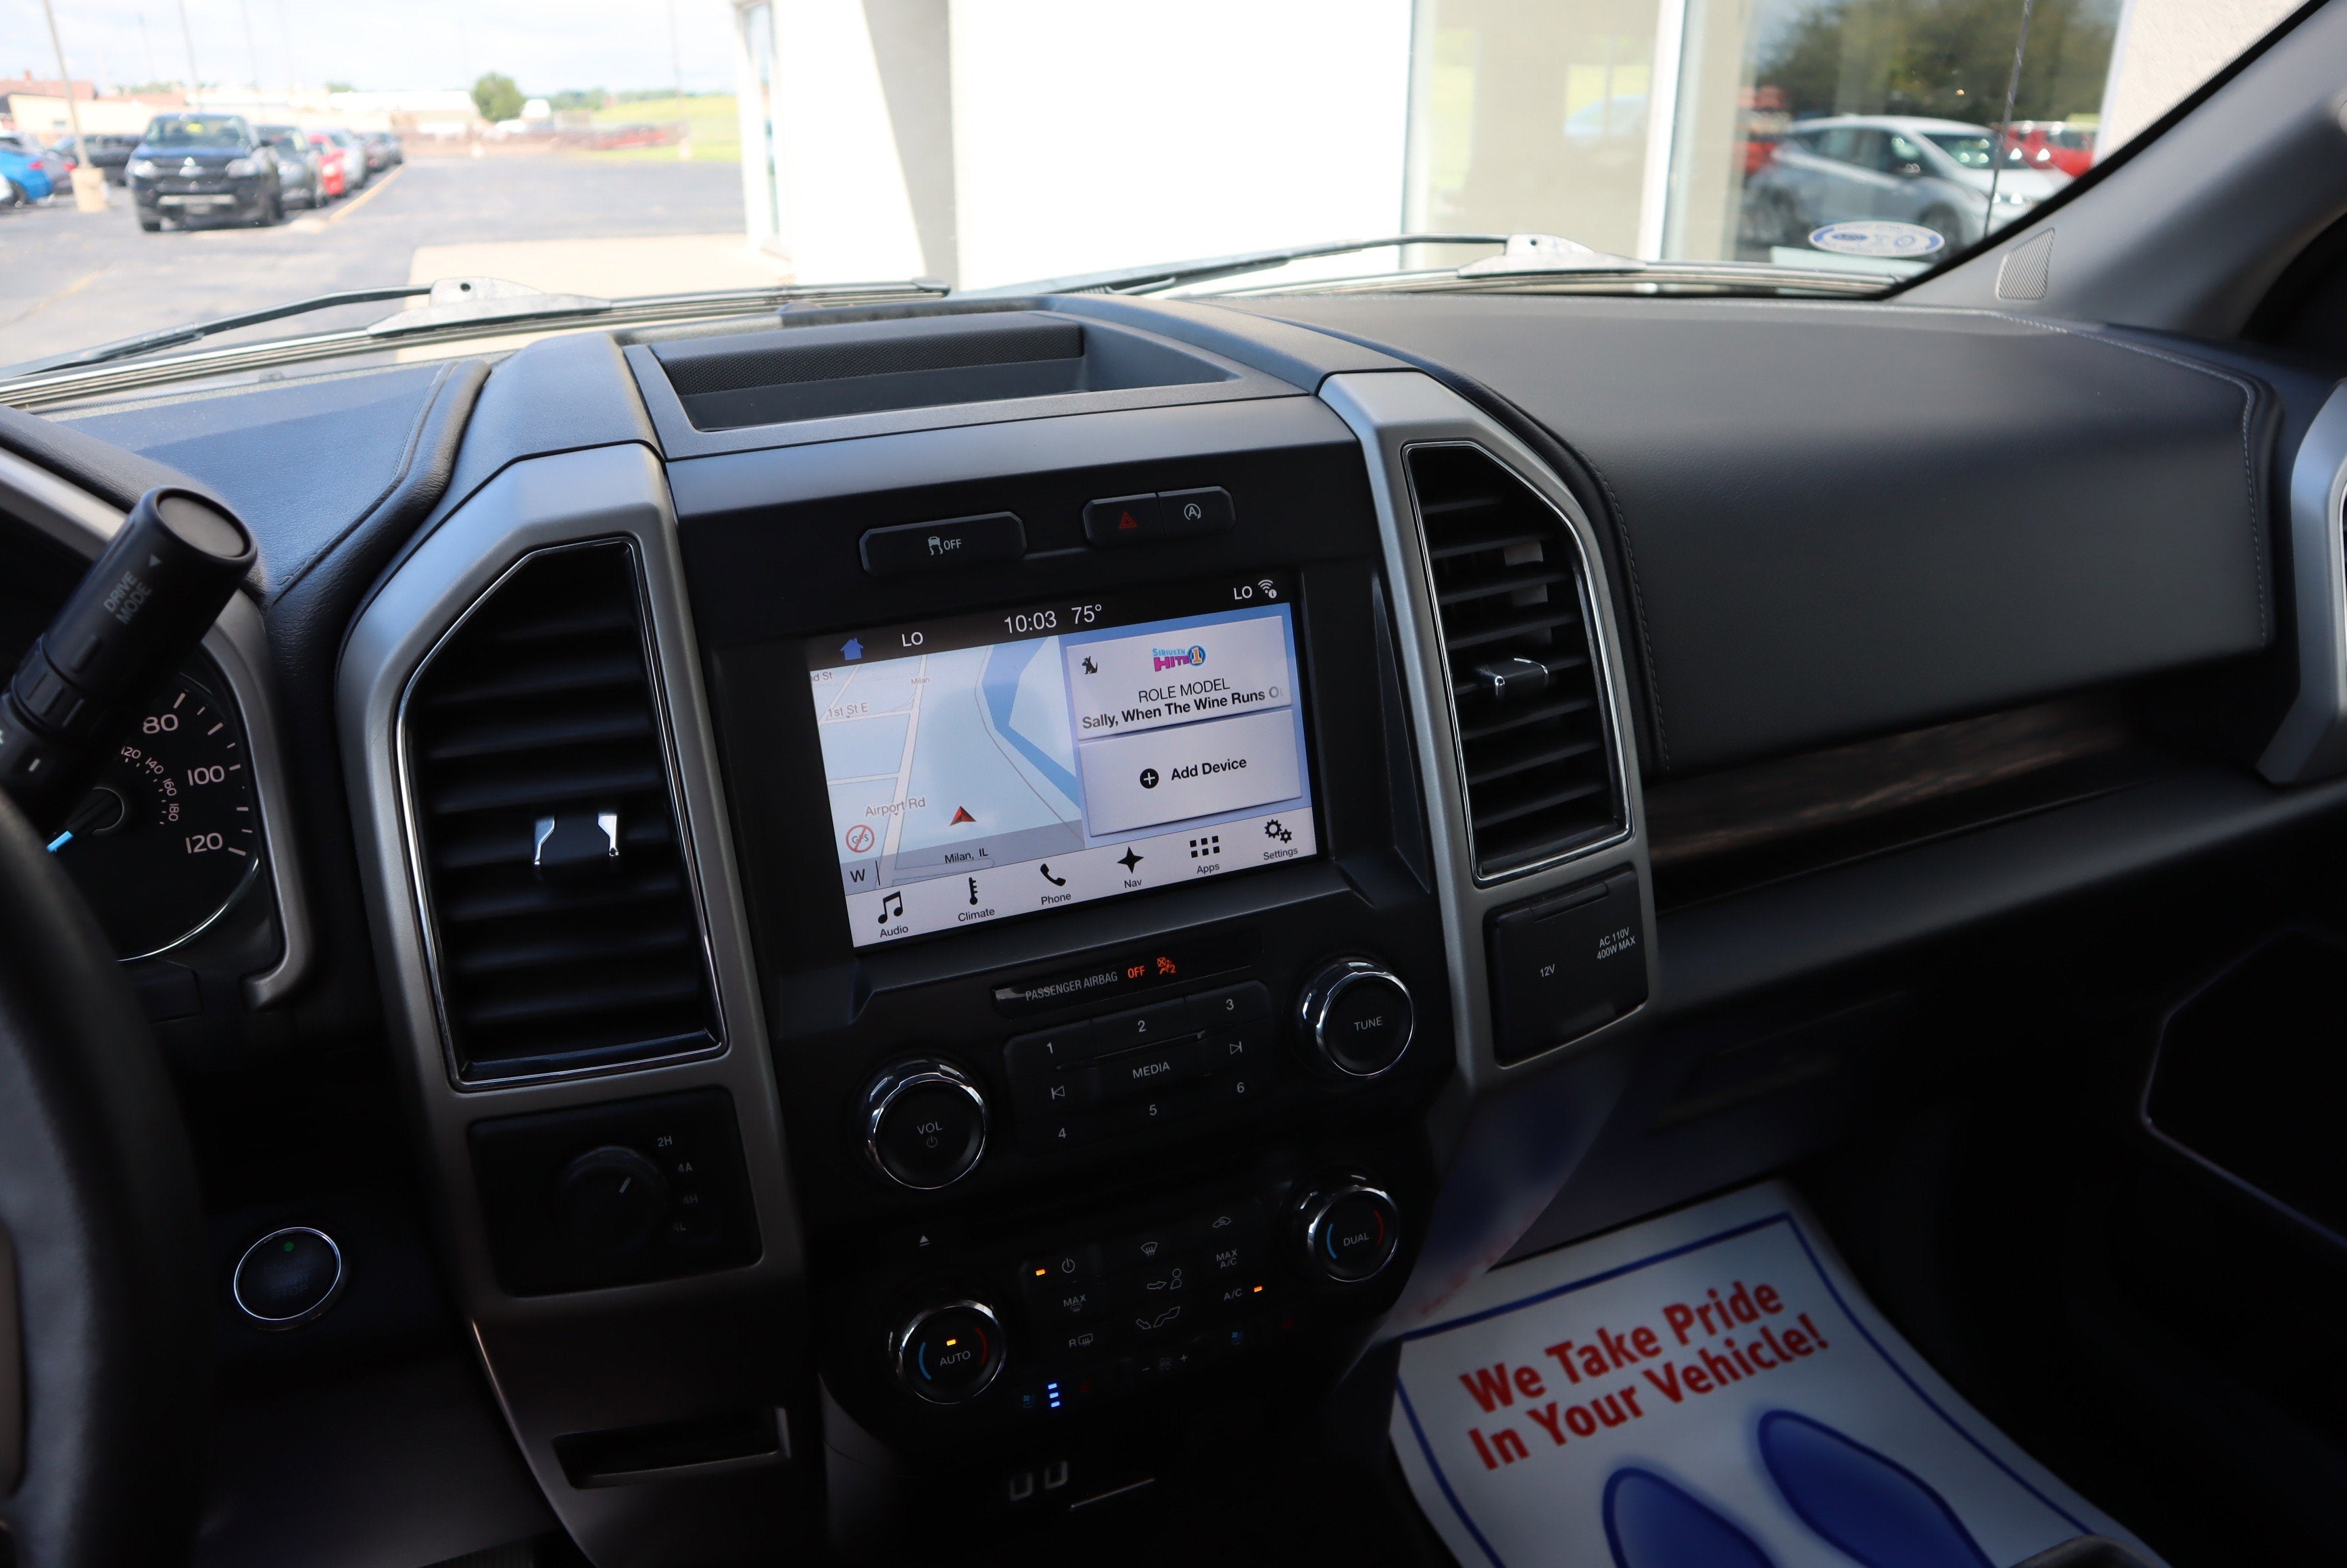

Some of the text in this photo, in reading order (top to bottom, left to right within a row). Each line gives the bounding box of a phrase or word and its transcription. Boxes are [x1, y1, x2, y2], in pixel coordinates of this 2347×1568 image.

[944, 538, 962, 552] OFF
[103, 570, 139, 612] DRIVE
[1234, 586, 1253, 599] LO
[116, 585, 153, 625] MODE
[1005, 604, 1102, 634] 10:03 75°
[901, 632, 923, 647] LO
[823, 672, 832, 681] St
[911, 677, 930, 685] Milan
[1138, 678, 1230, 703] ROLE MODEL
[827, 702, 869, 717] 1st St E
[1082, 686, 1282, 729] Sally, When The Wine Runs O
[143, 714, 178, 735] 80
[120, 745, 142, 760] 120
[145, 757, 164, 775] 140
[1171, 758, 1247, 781] Add Device
[187, 765, 225, 786] 100
[162, 778, 177, 797] 160
[168, 802, 179, 822] 180
[865, 796, 925, 817] Airport Rd
[185, 832, 223, 854] 120
[944, 848, 988, 864] Milan, IL
[1263, 847, 1298, 860] Settings
[850, 868, 865, 883] W
[1196, 862, 1219, 875] Apps
[1124, 879, 1142, 889] Nav
[1041, 893, 1071, 905] Phone
[958, 908, 995, 923] Climate
[880, 925, 909, 938] Audio
[1599, 927, 1630, 948] AC 110V
[1597, 935, 1637, 960] 400W MAX
[1540, 964, 1555, 977] 12V
[1025, 965, 1146, 1001] PASSENGER AIRBAG OFF
[1226, 999, 1234, 1010] 3
[1137, 1021, 1146, 1032] 2
[1354, 1016, 1383, 1031] TUNE
[1046, 1042, 1053, 1054] 1
[1132, 1061, 1170, 1079] MEDIA
[1237, 1082, 1244, 1093] 6
[1149, 1104, 1157, 1116] 5
[917, 1121, 943, 1135] VOL
[1058, 1128, 1067, 1139] 4
[657, 1135, 673, 1147] 2H
[677, 1162, 693, 1173] 4A
[683, 1194, 698, 1205] 4H
[673, 1222, 687, 1232] 4L
[1343, 1232, 1370, 1246] DUAL
[1216, 1249, 1238, 1261] MAX
[1220, 1258, 1237, 1269] A/C
[1063, 1294, 1086, 1306] MAX
[1224, 1288, 1243, 1300] A/C
[1069, 1338, 1077, 1347] R
[1460, 1281, 1784, 1414] We Take Pride
[940, 1351, 971, 1367] AUTO
[1468, 1313, 1829, 1470] In Your Vehicle!
